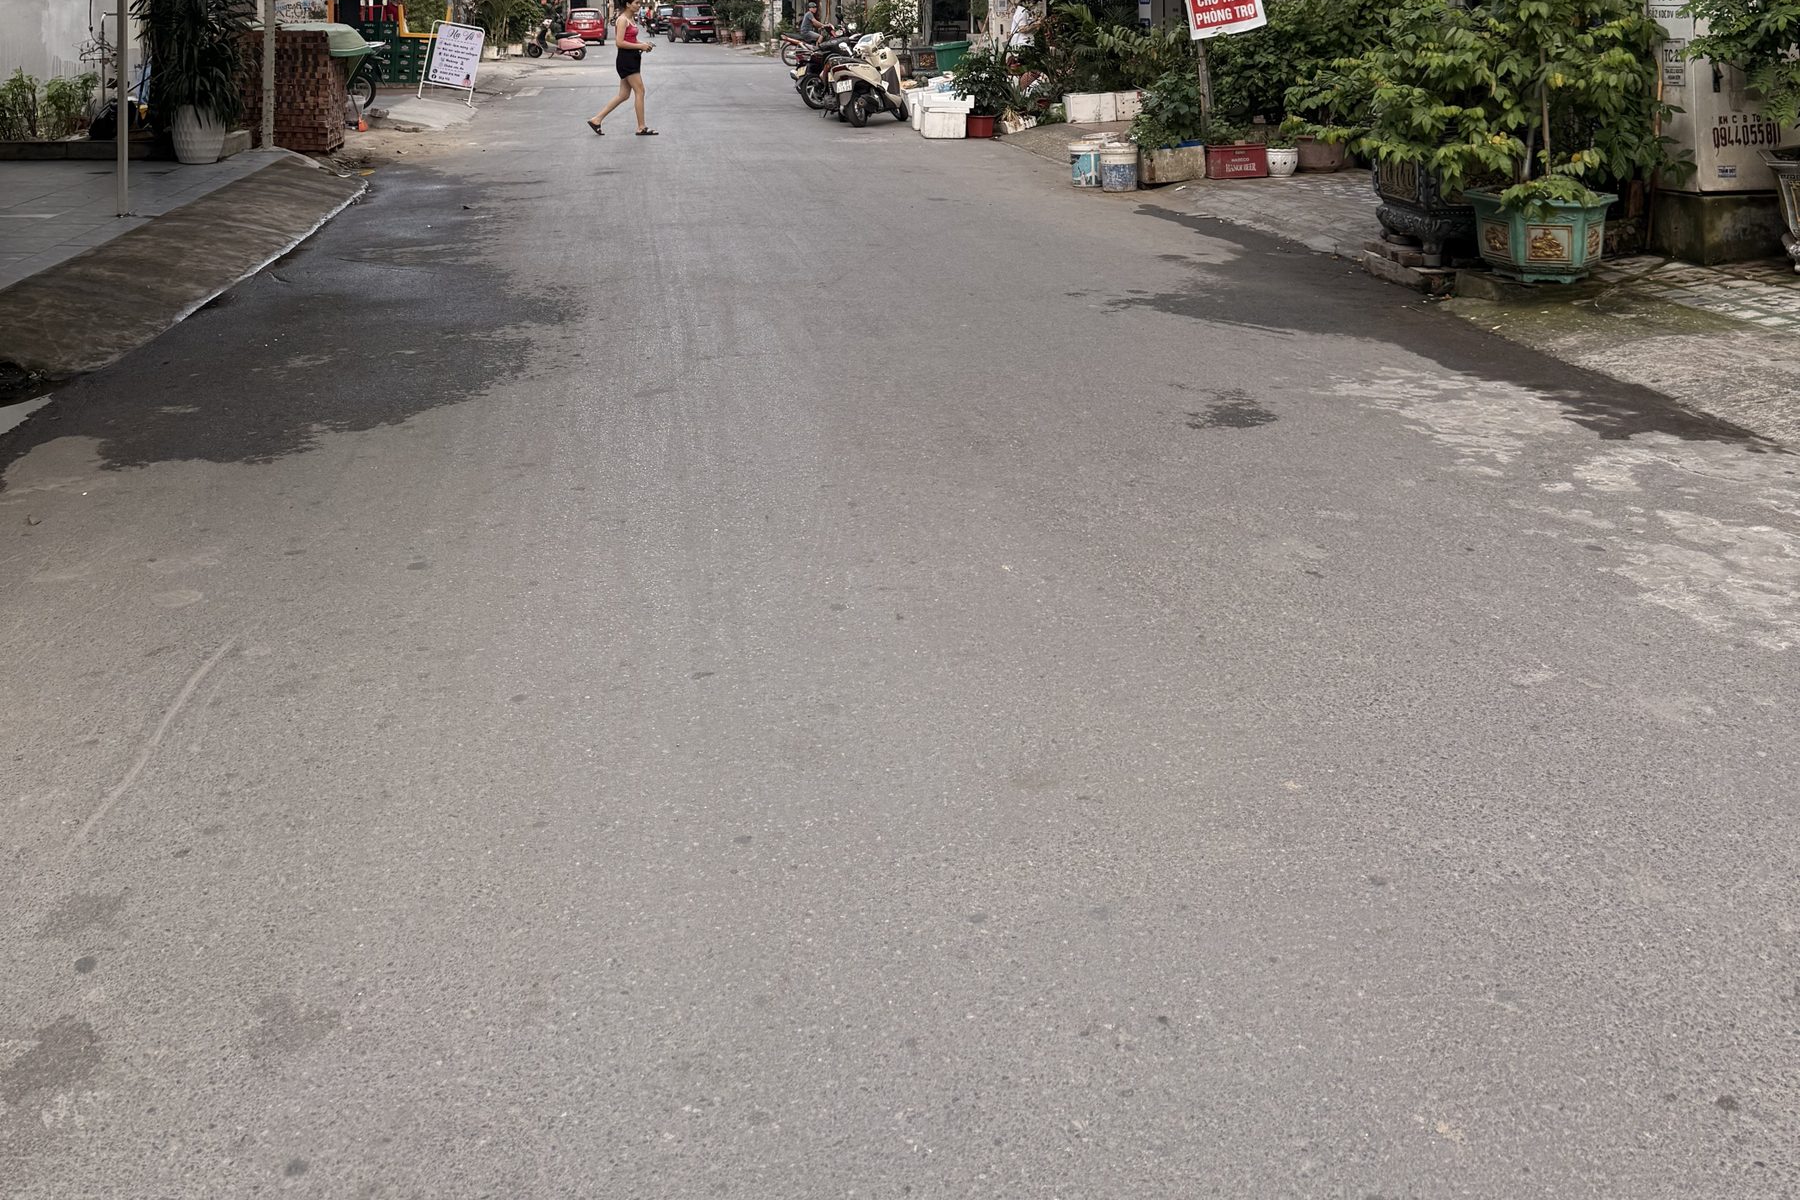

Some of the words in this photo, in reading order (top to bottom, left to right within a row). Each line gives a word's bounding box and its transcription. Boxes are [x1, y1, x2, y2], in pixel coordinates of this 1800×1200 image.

[1195, 7, 1233, 26] PHÒNG
[1233, 3, 1255, 18] TRỌ
[1712, 122, 1781, 149] 0944055811
